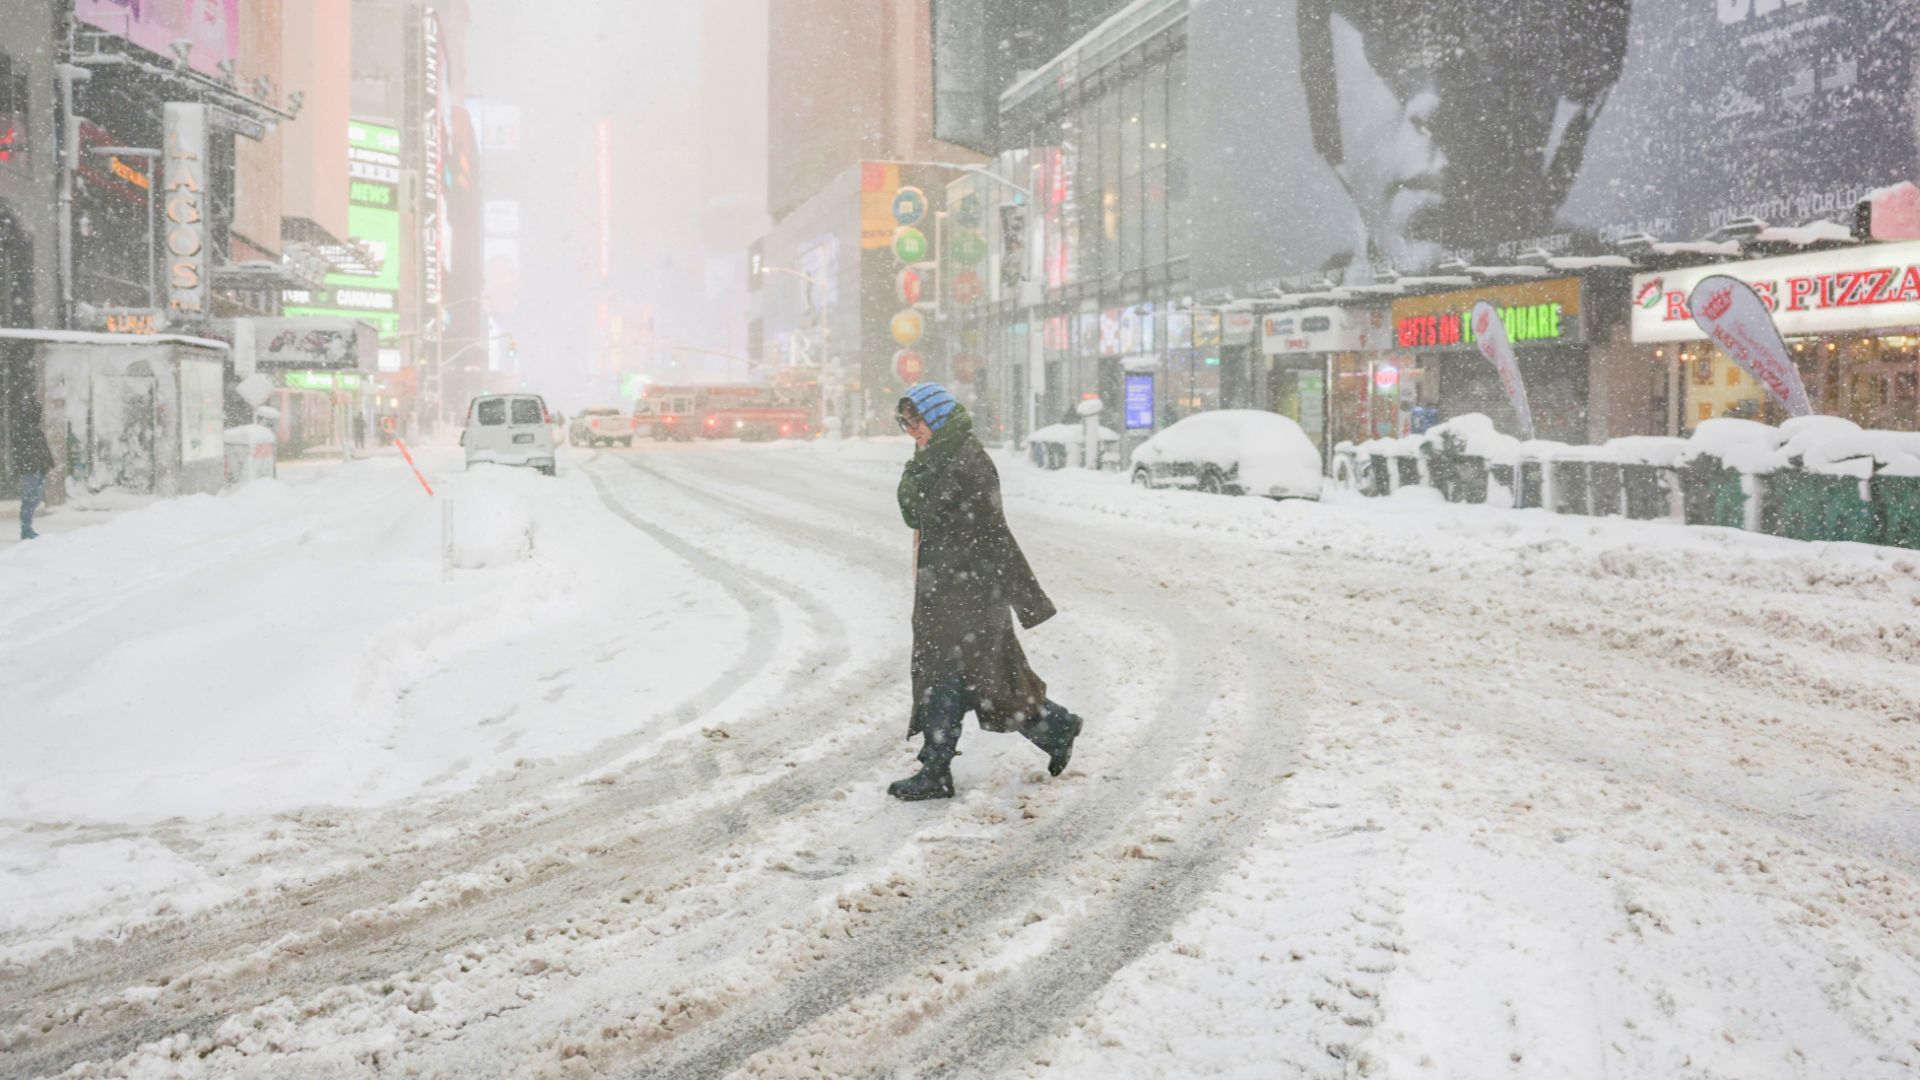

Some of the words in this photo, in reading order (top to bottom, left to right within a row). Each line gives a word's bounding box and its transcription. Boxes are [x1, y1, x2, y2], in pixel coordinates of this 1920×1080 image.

[351, 181, 390, 204] NEWS
[1798, 187, 1857, 218] WORLD
[167, 131, 201, 289] LAGOS
[337, 289, 392, 309] CANNABIS
[1787, 265, 1920, 311] PIZZA
[1398, 316, 1436, 347] GIFTS
[1440, 313, 1460, 346] ON
